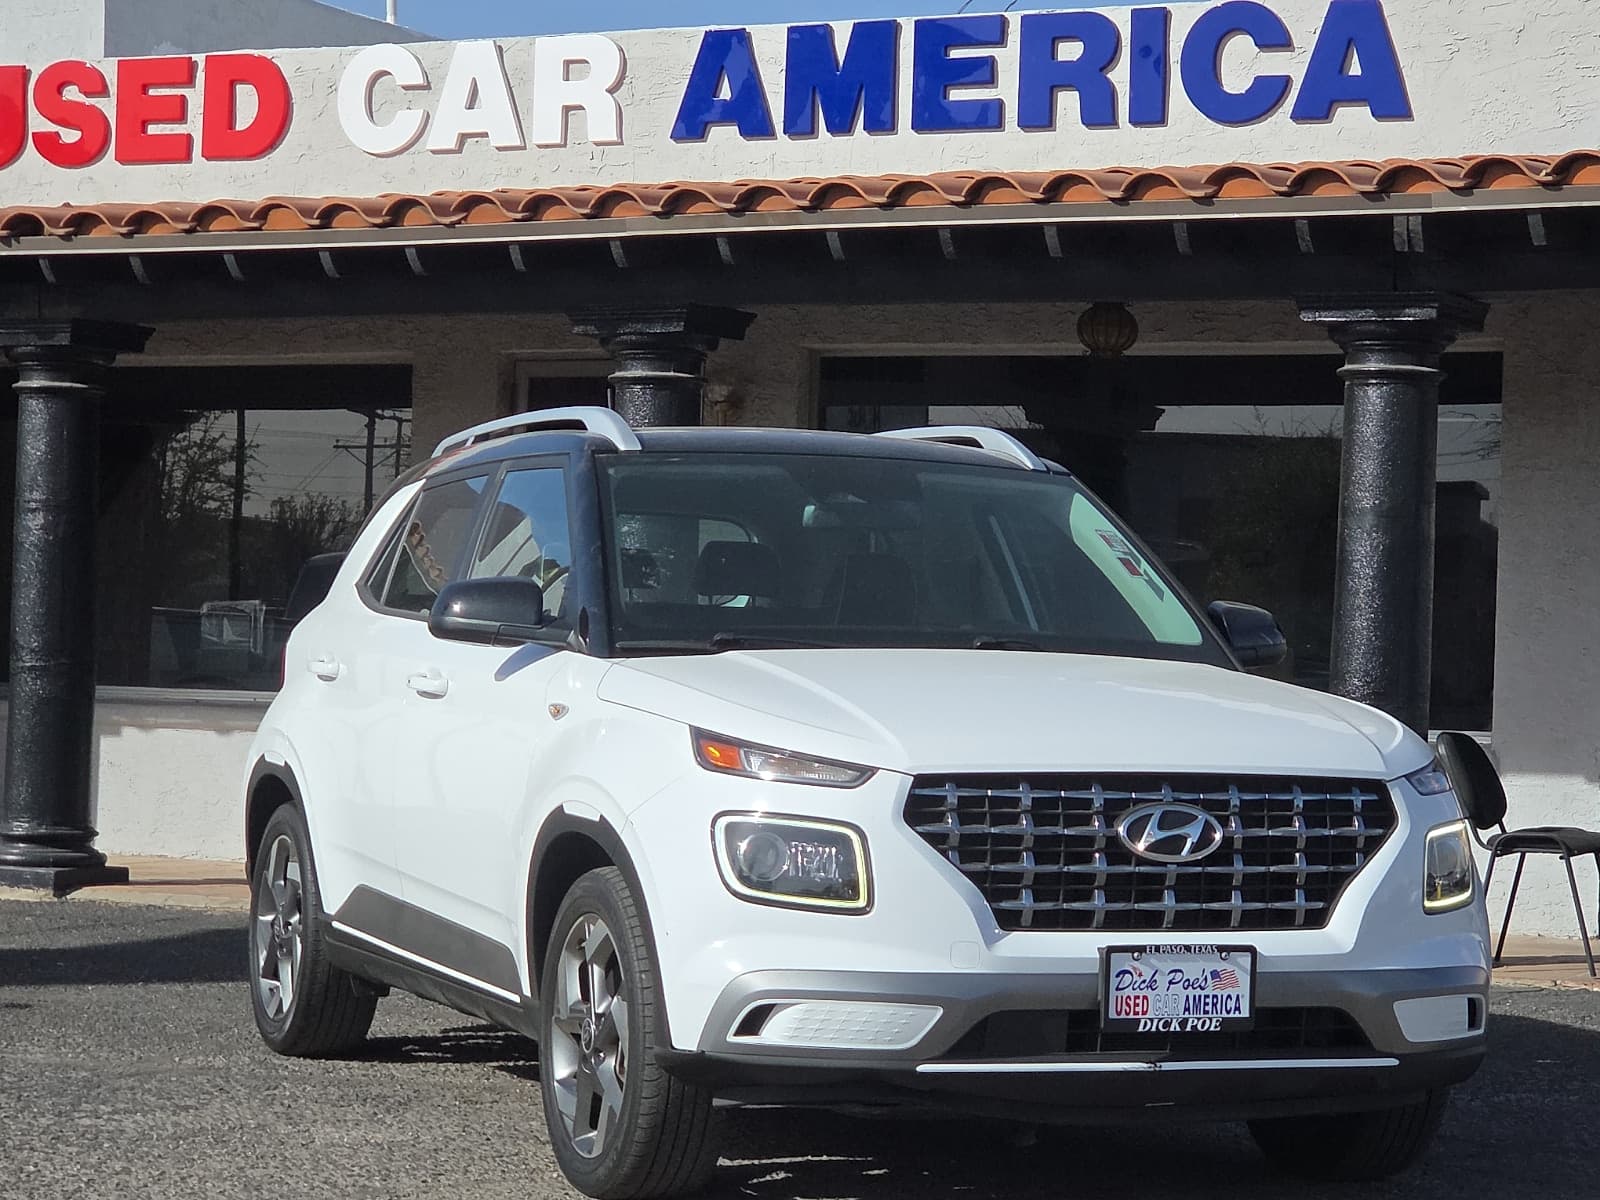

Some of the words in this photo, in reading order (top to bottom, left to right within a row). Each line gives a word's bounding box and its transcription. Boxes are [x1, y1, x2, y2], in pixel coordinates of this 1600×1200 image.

[337, 35, 625, 156] CAR
[670, 0, 1413, 141] AMERICA
[1146, 944, 1158, 954] EL
[1190, 944, 1218, 954] TEXAS
[1115, 968, 1159, 991] Dick
[1166, 968, 1209, 992] Poe's
[1115, 994, 1149, 1016] USED
[1153, 993, 1180, 1016] CAR
[1182, 993, 1242, 1015] AMERICA
[1137, 1017, 1181, 1032] DICK
[1184, 1017, 1222, 1031] POE
